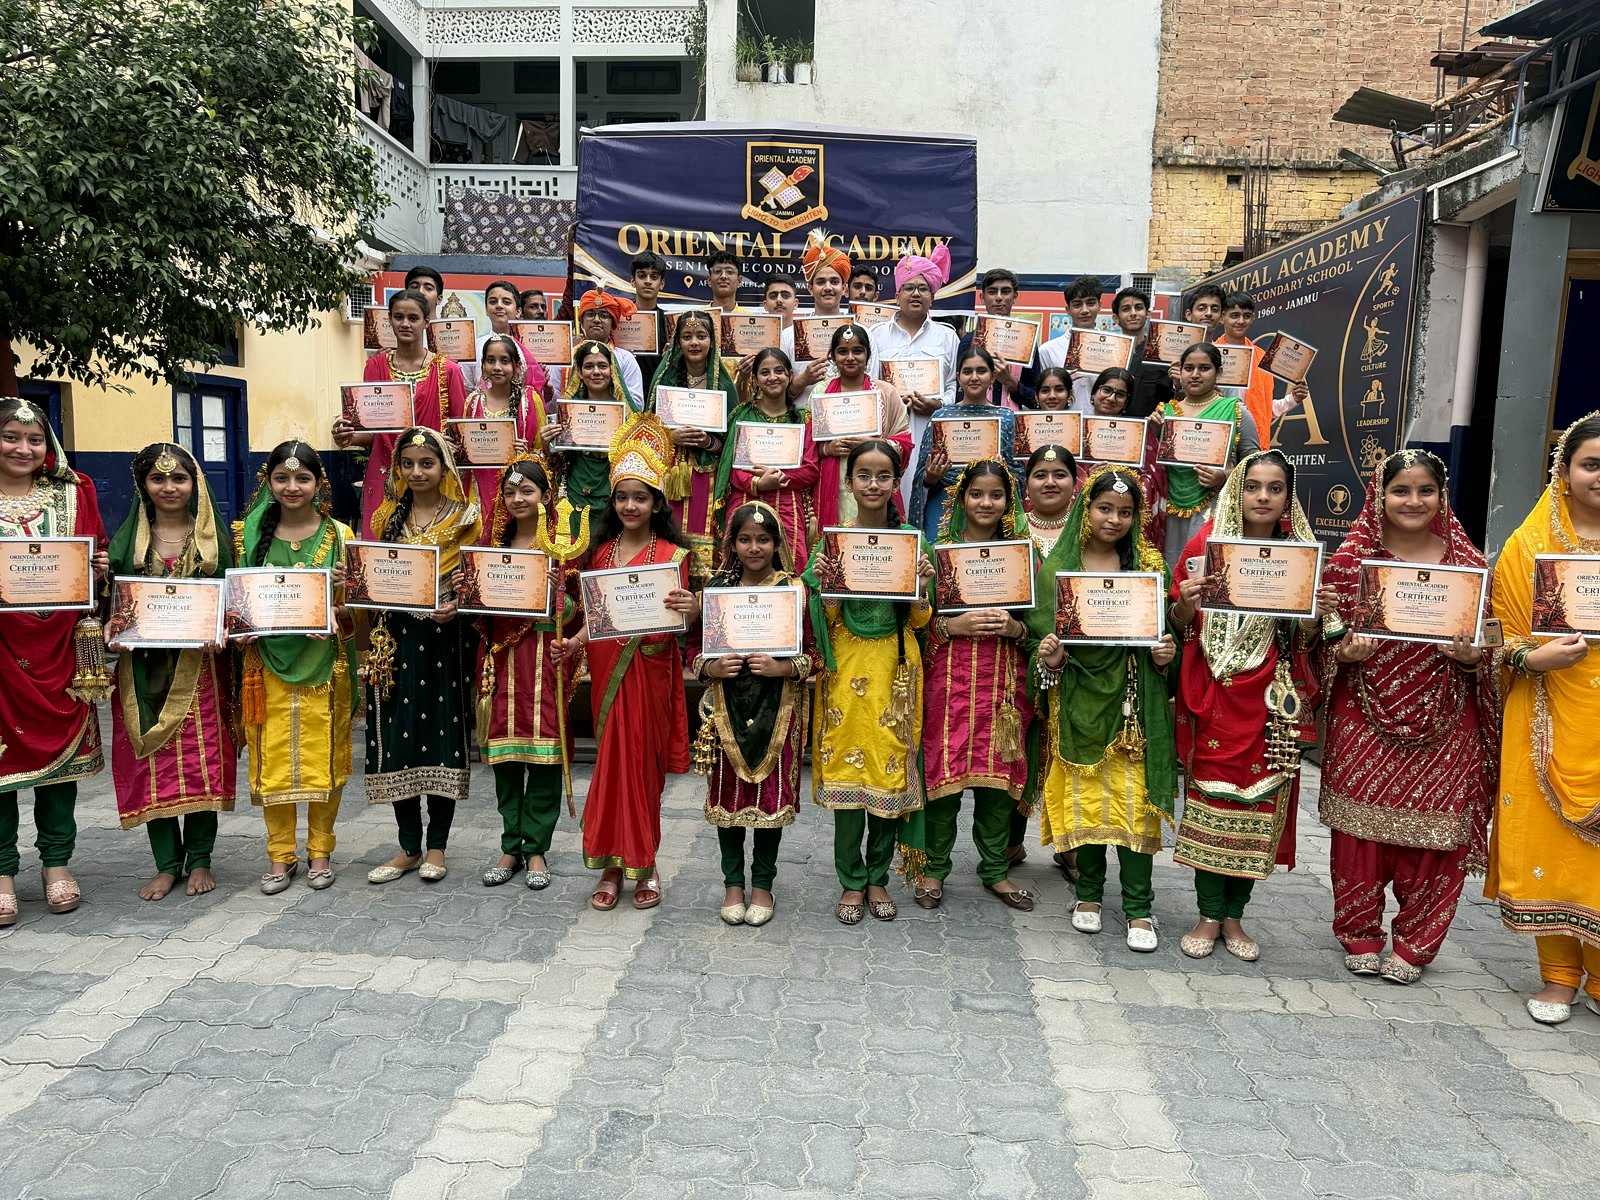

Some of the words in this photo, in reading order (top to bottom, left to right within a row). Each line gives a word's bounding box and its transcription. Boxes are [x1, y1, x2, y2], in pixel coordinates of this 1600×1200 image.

[754, 155, 785, 163] ORIENTAL
[787, 155, 816, 164] ACADEMY
[747, 208, 768, 221] LIGHT
[784, 208, 822, 228] ENLIGHTEN
[618, 224, 792, 258] ORIENTAL
[1220, 266, 1272, 293] ENTAL
[1277, 216, 1391, 280] ACADEMY
[1252, 277, 1304, 303] ECONDARY
[1307, 260, 1353, 286] SCHOOL
[1258, 306, 1276, 318] 1960
[1285, 292, 1319, 310] JAMMU
[1373, 300, 1394, 311] SPORTS
[1360, 362, 1387, 372] CULTURE
[1356, 418, 1390, 427] LEADERSHIP
[1288, 454, 1326, 465] GHTEN
[9, 564, 60, 572] CERTIFICATE
[373, 567, 412, 576] CERTIFICATE
[965, 567, 1006, 575] CERTIFICATE
[1240, 567, 1287, 577] CERTIFICATE
[487, 572, 526, 581] CERTIFICATE
[616, 592, 656, 602] CERTIFICATE
[1395, 591, 1448, 602] CERTIFICATE
